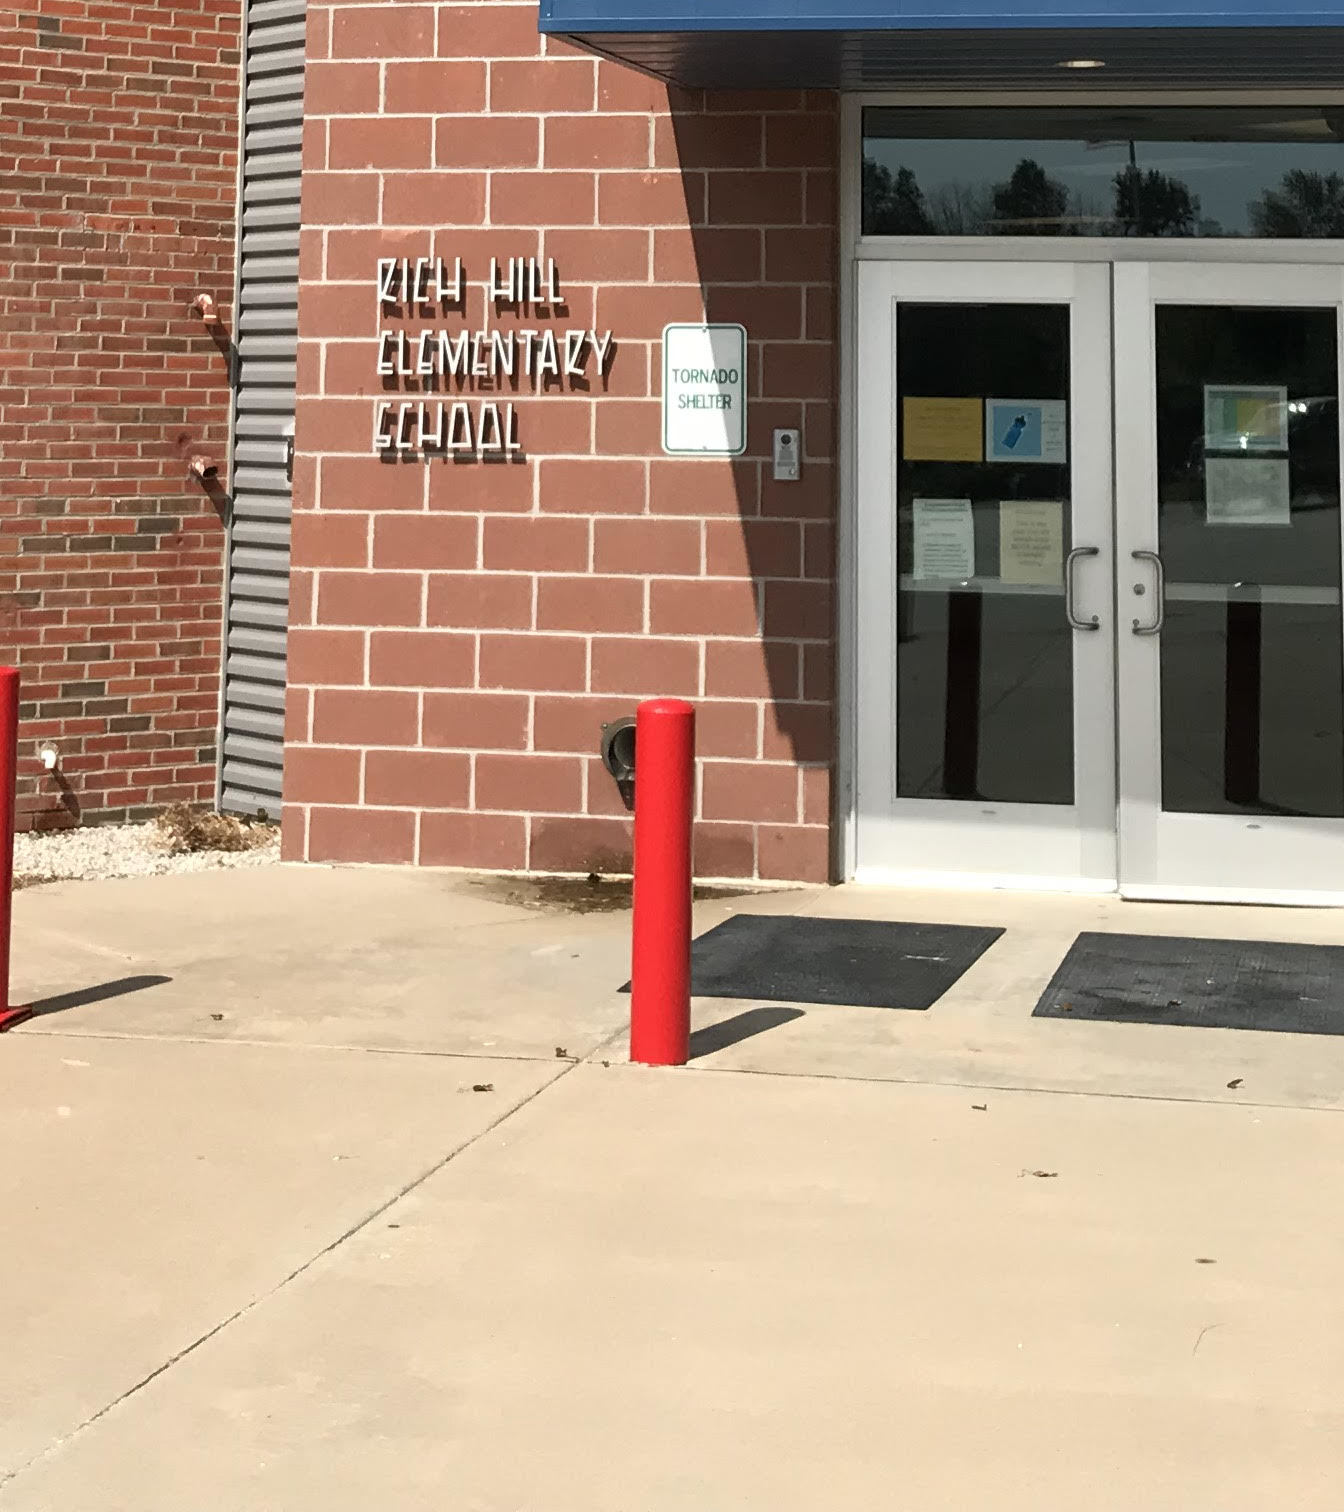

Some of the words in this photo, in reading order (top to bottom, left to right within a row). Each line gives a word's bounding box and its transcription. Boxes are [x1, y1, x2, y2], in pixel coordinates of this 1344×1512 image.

[376, 256, 461, 303] RICH
[490, 256, 565, 303] HILL
[376, 329, 614, 376] ELEMENTARY
[672, 368, 739, 385] TORNADO
[375, 402, 521, 449] SCHOOL
[678, 394, 732, 410] SHELTER
